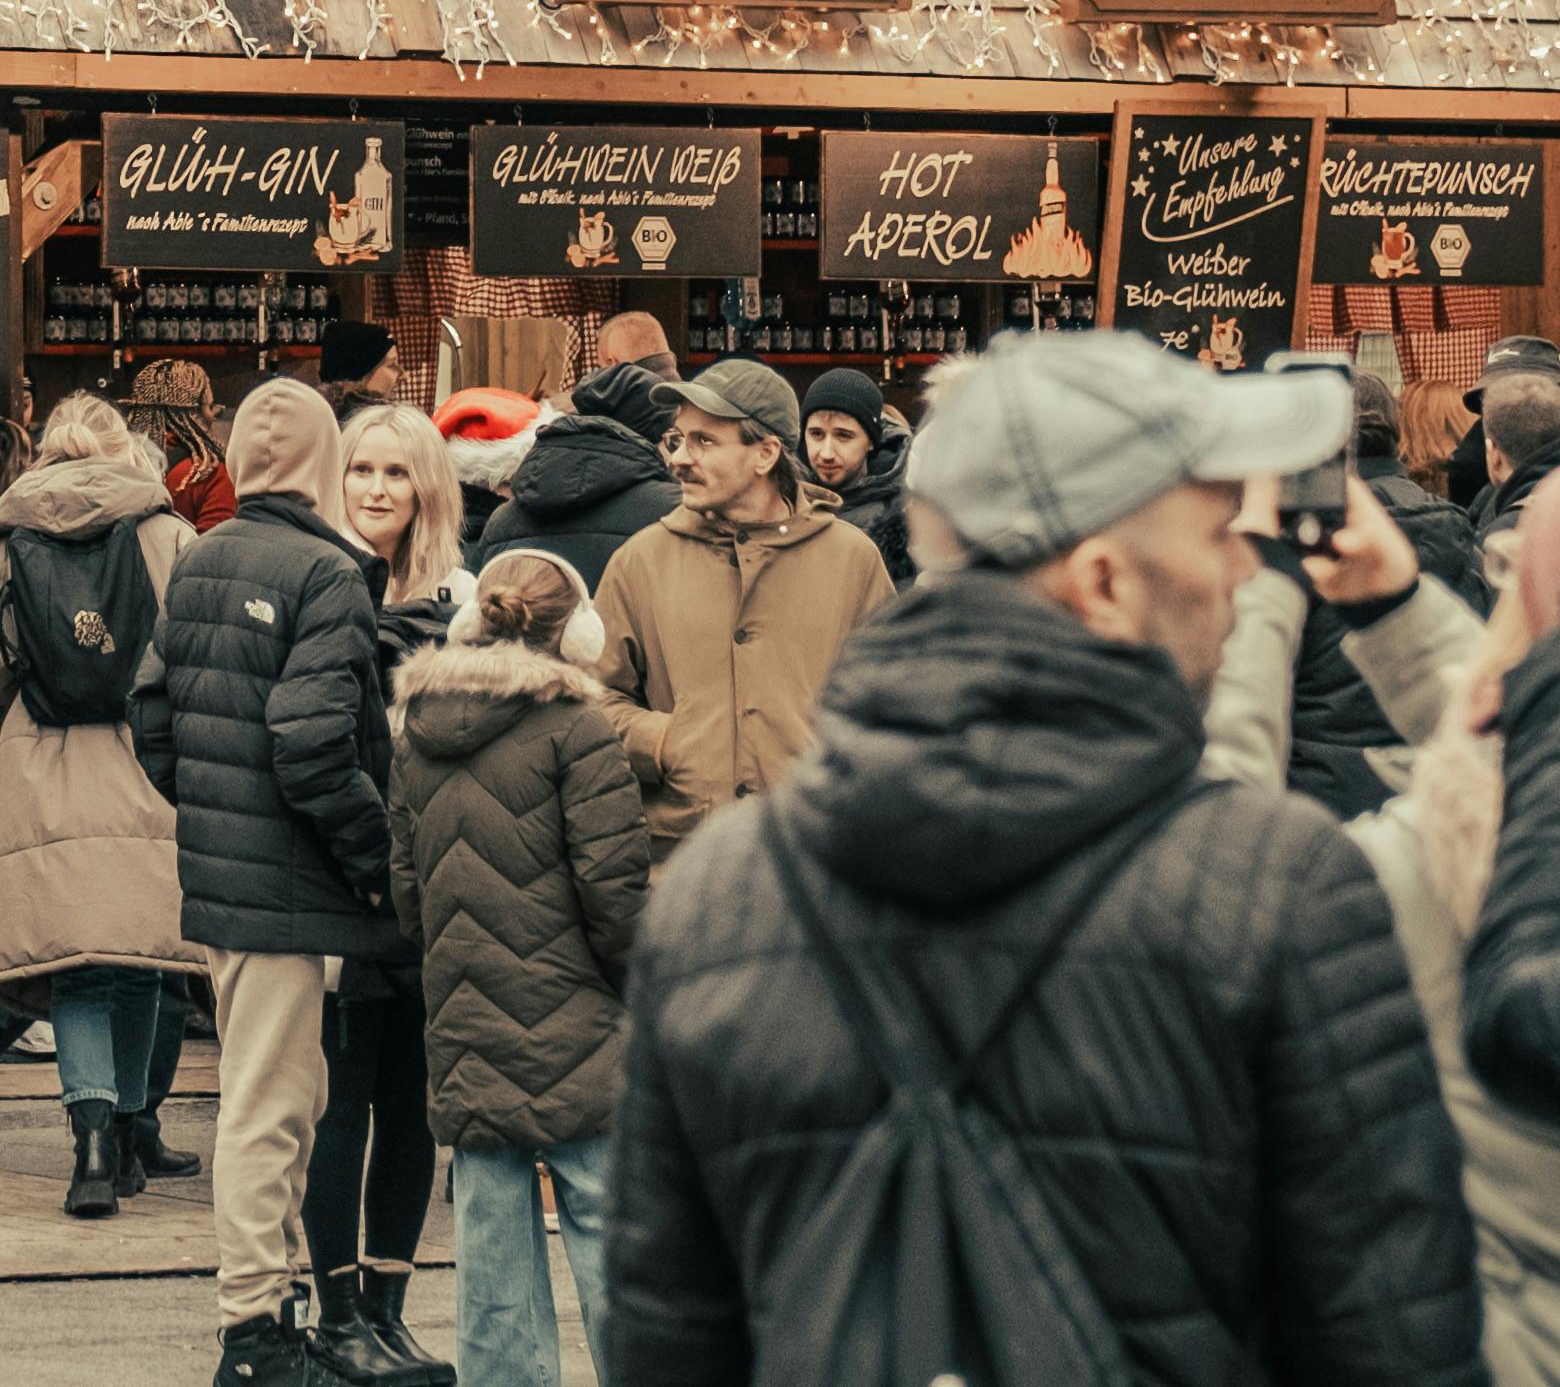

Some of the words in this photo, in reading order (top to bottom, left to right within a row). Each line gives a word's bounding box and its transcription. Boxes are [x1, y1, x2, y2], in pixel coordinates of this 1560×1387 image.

[119, 126, 340, 202] GLÜH-GIN
[492, 131, 665, 188] GLÜHWEIN
[668, 143, 742, 193] WEIß
[879, 150, 974, 200] HOT
[1178, 133, 1258, 176] Unsere
[1320, 148, 1535, 199] RÜCHTEPUNSCH
[364, 197, 384, 212] GIN
[1162, 159, 1285, 229] Empfehlung
[126, 211, 159, 231] nach
[211, 212, 309, 238] Familienrezept
[642, 230, 668, 243] BIO
[843, 211, 993, 266] APEROL
[1124, 280, 1286, 313] Bio-Glühwein
